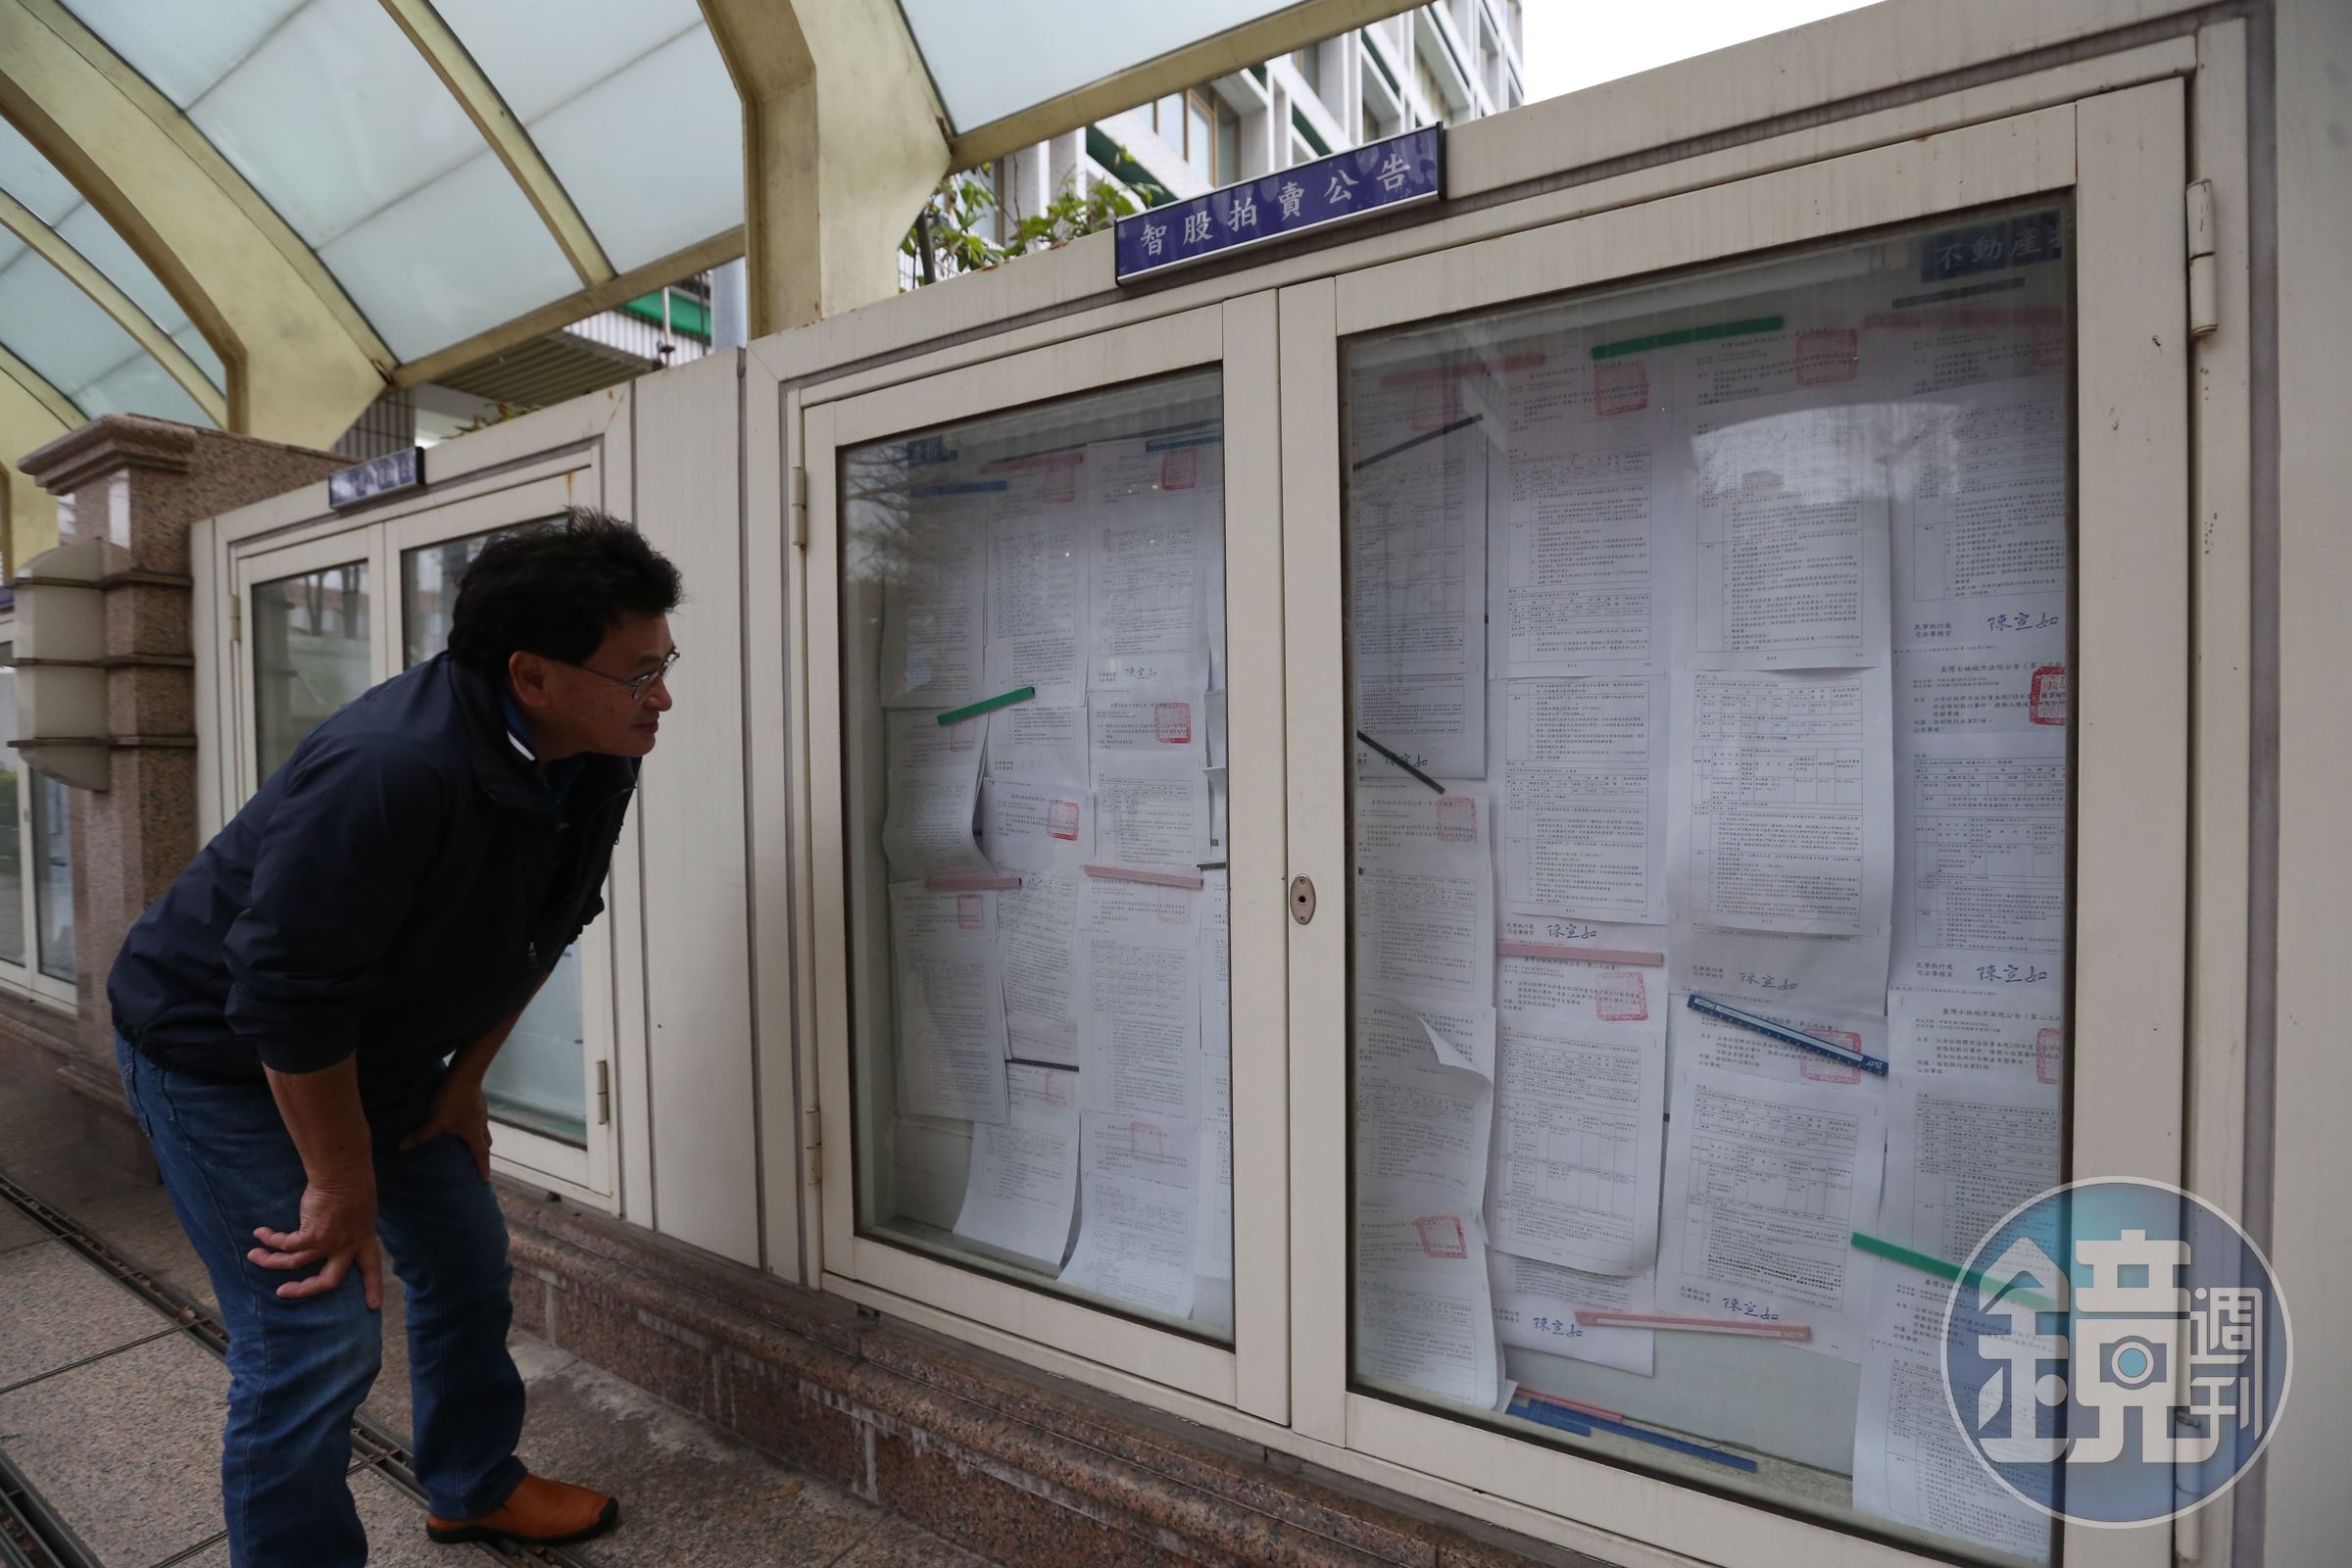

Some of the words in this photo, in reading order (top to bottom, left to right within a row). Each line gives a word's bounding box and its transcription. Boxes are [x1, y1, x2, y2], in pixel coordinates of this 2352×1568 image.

[1141, 153, 1410, 257] 智股拍賣公告
